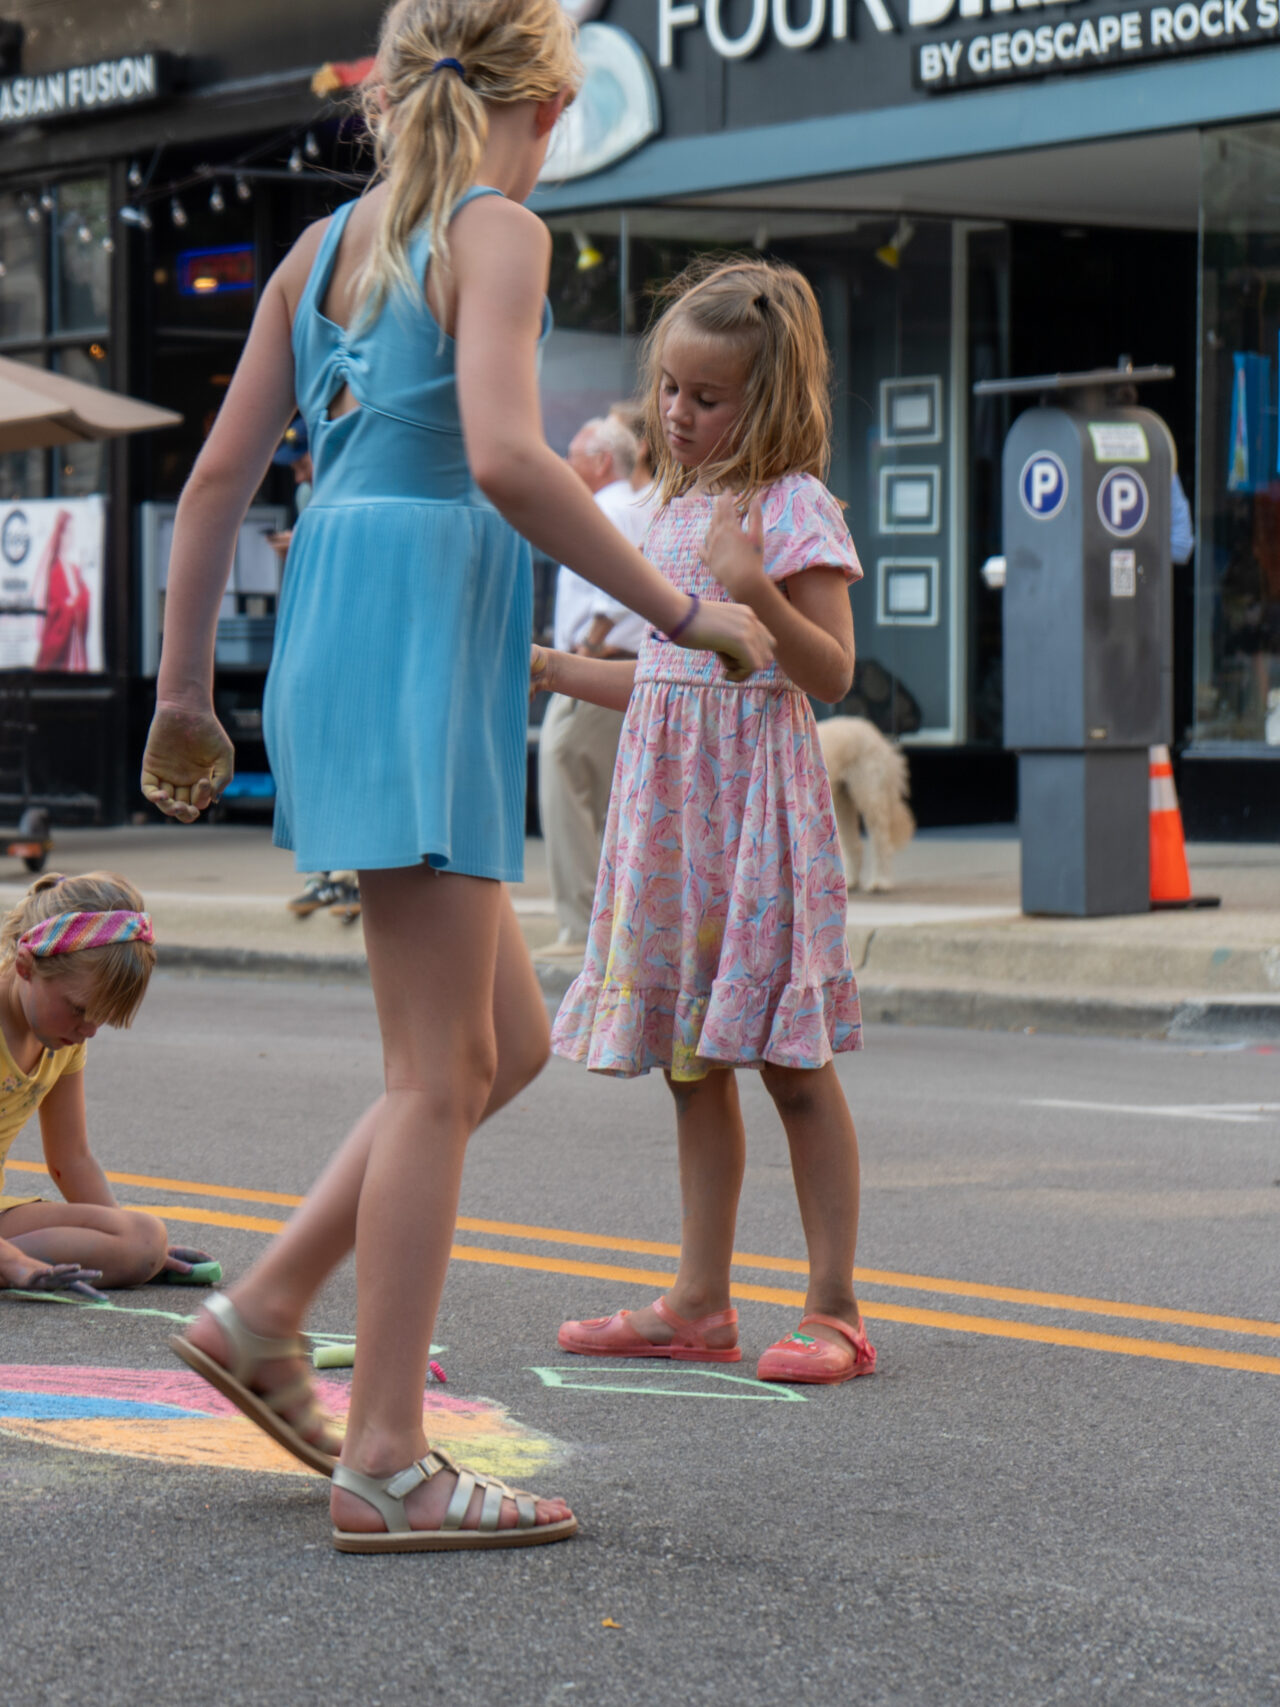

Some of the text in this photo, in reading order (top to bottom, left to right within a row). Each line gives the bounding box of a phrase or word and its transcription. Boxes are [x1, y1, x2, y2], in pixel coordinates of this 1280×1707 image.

[920, 40, 963, 80] BY
[968, 12, 1143, 72] GEOSCAPE
[1150, 0, 1250, 45] ROCK
[68, 54, 155, 106] FUSION
[1031, 461, 1059, 510] P
[1110, 477, 1138, 526] P
